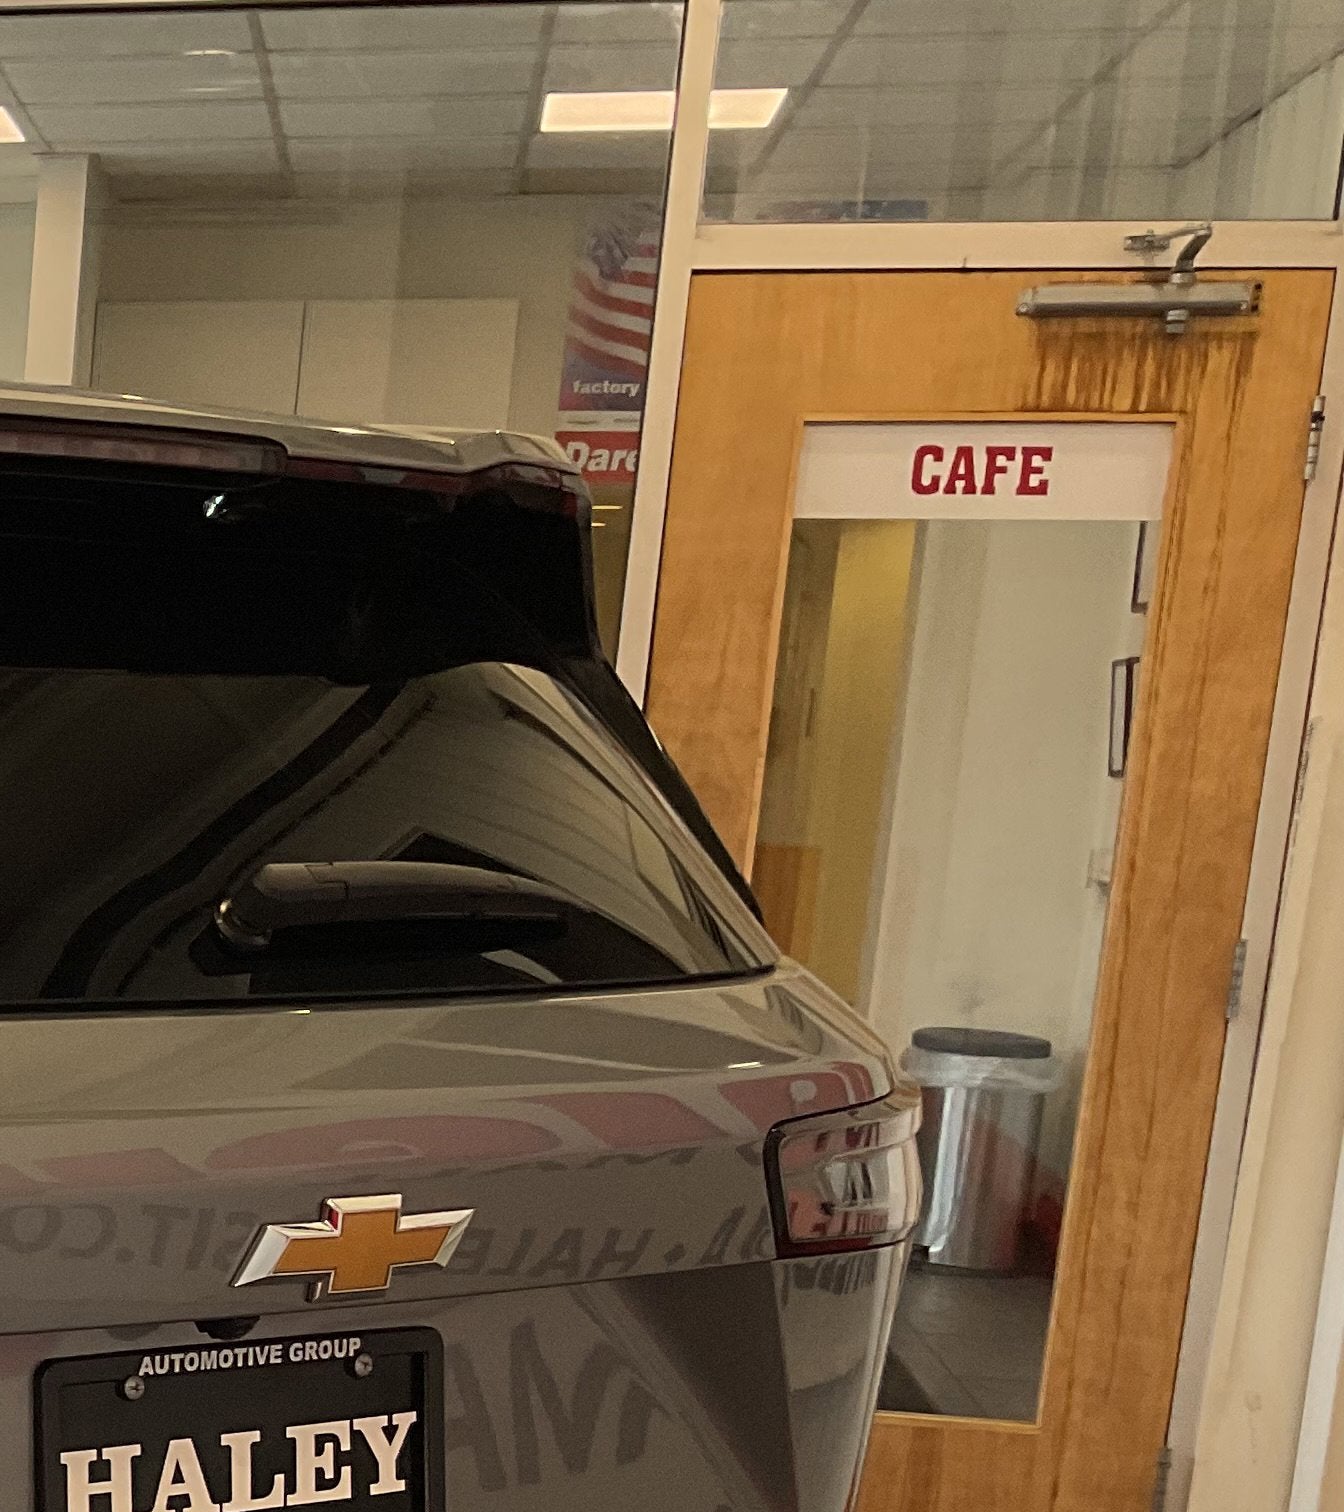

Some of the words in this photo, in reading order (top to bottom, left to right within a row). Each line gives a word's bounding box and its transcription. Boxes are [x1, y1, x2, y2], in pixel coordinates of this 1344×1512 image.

[572, 380, 640, 397] factory
[911, 444, 1054, 496] CAFE
[138, 1343, 283, 1377] AUTOMOTIVE
[288, 1336, 362, 1362] GROUP
